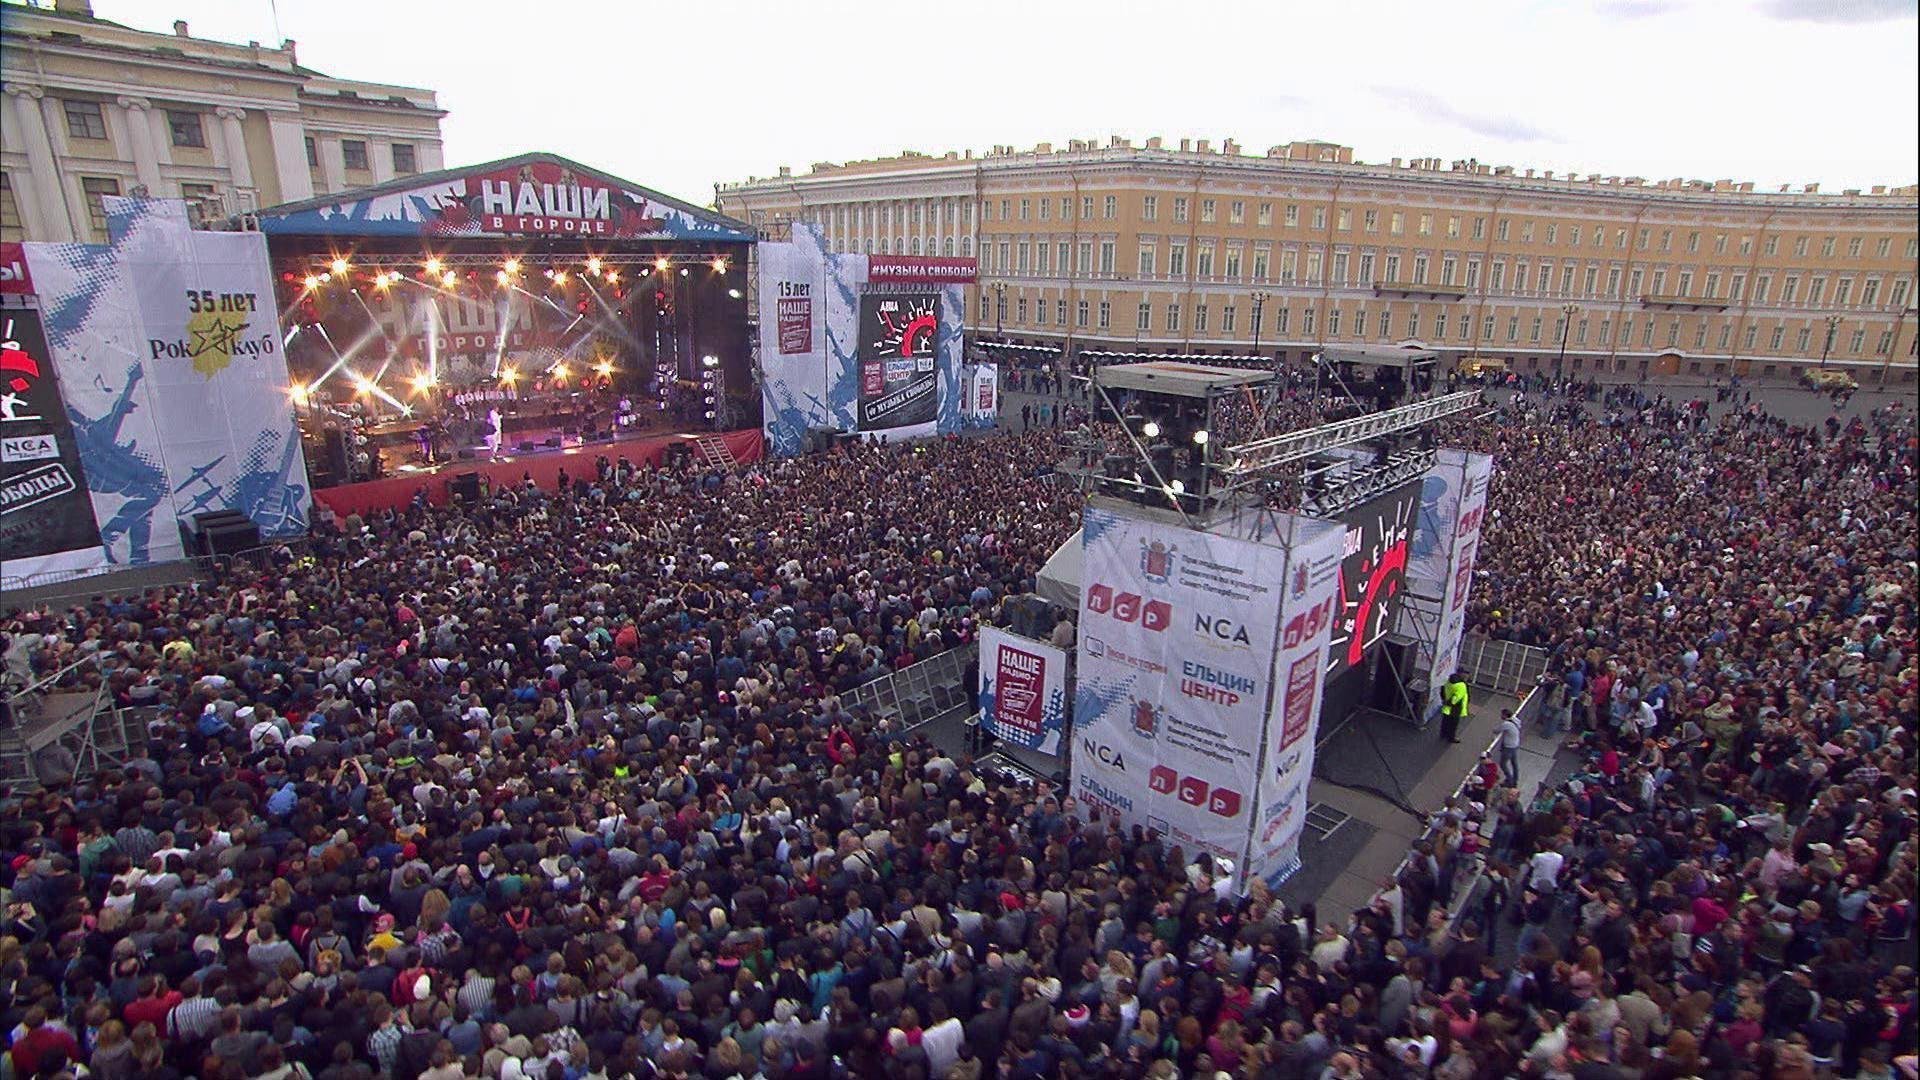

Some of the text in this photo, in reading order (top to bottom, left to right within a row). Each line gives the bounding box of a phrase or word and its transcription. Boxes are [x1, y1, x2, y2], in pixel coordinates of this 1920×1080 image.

[482, 180, 611, 219] НАШИ
[493, 217, 604, 234] В ГОРОДЕ
[872, 265, 976, 276] #МУЗЫКА СВОБОДЫ
[778, 282, 810, 296] 15 лет
[187, 290, 257, 313] 35 лет
[779, 302, 810, 315] НАШЕ
[149, 339, 194, 360] Рок
[5, 440, 51, 453] NCA
[1195, 612, 1251, 646] NCA
[1001, 650, 1041, 675] НАШЕ
[1001, 666, 1031, 681] РАДИО
[1182, 660, 1255, 695] ЕЛЬЦИН
[1180, 678, 1240, 707] ЦЕНТР
[1083, 737, 1126, 772] NCA
[1080, 774, 1133, 812] ЕЛЬЦИН
